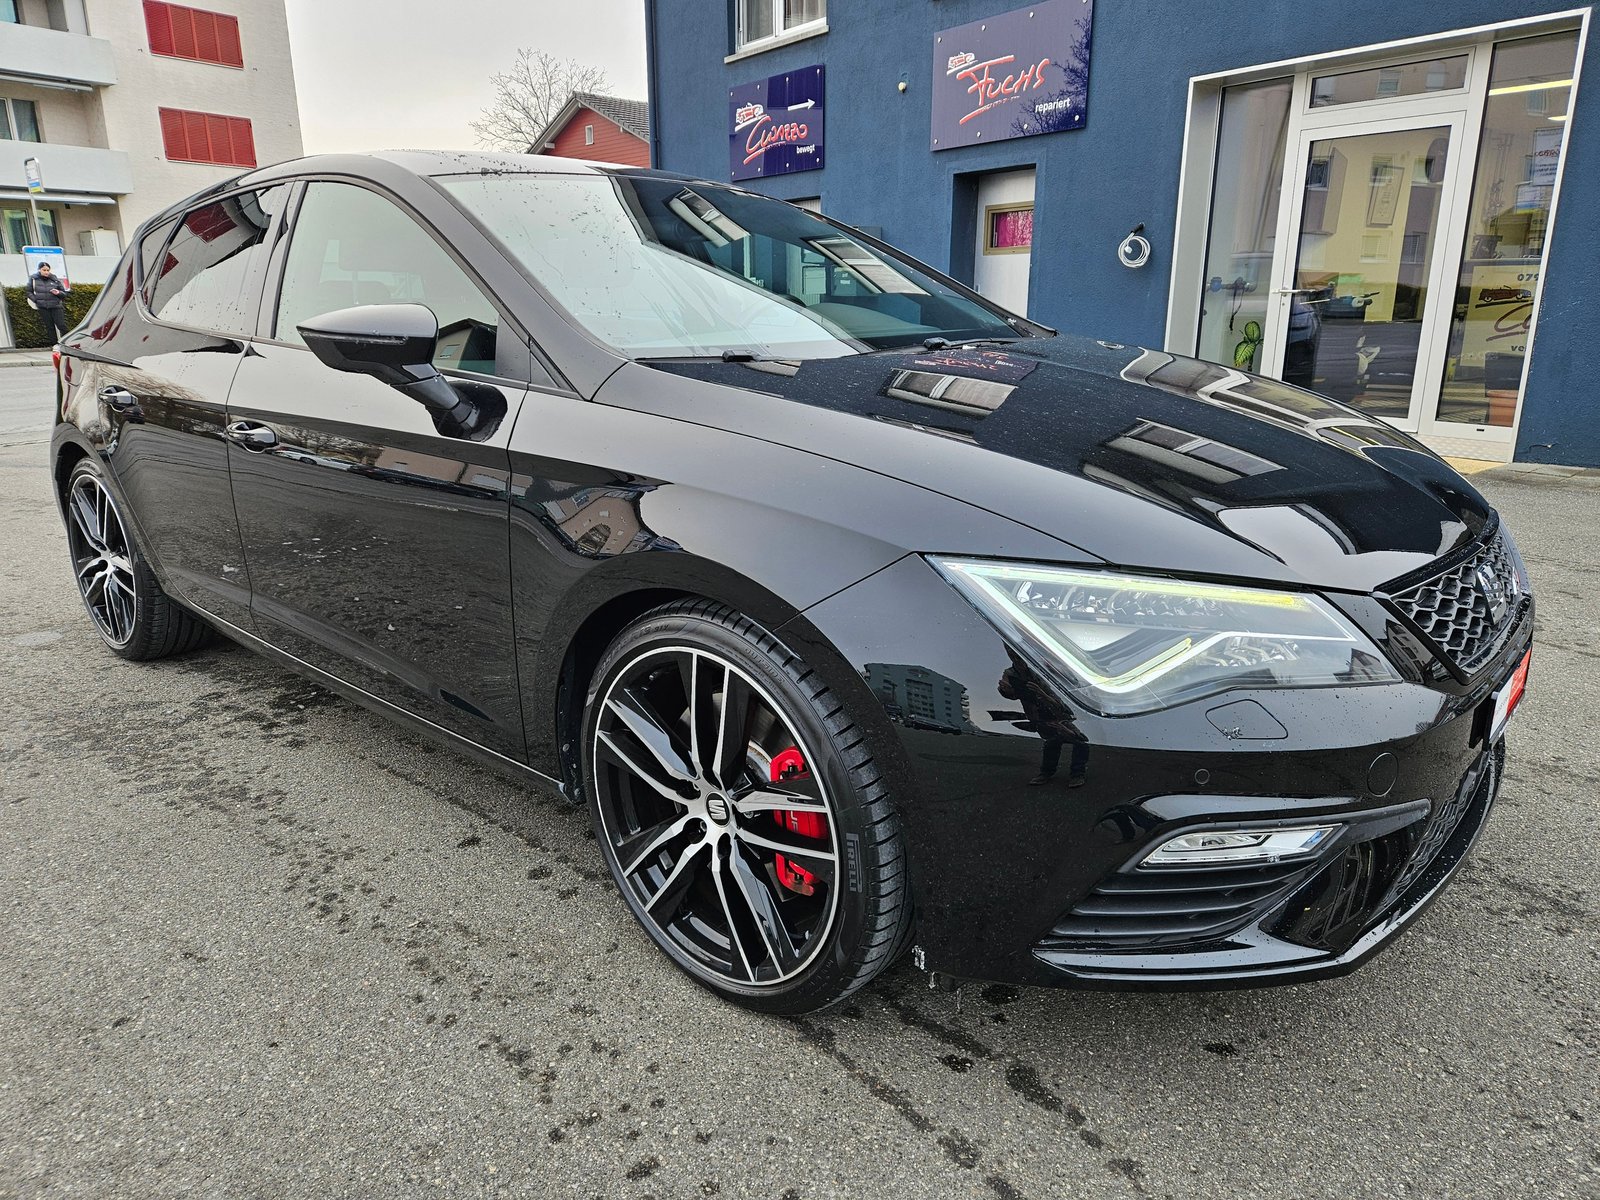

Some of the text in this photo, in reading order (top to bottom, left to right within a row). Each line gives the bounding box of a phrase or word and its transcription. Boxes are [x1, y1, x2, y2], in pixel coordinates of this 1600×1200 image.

[1035, 97, 1071, 114] repariert
[796, 143, 815, 154] bewegt
[846, 832, 863, 893] PIRELLI
